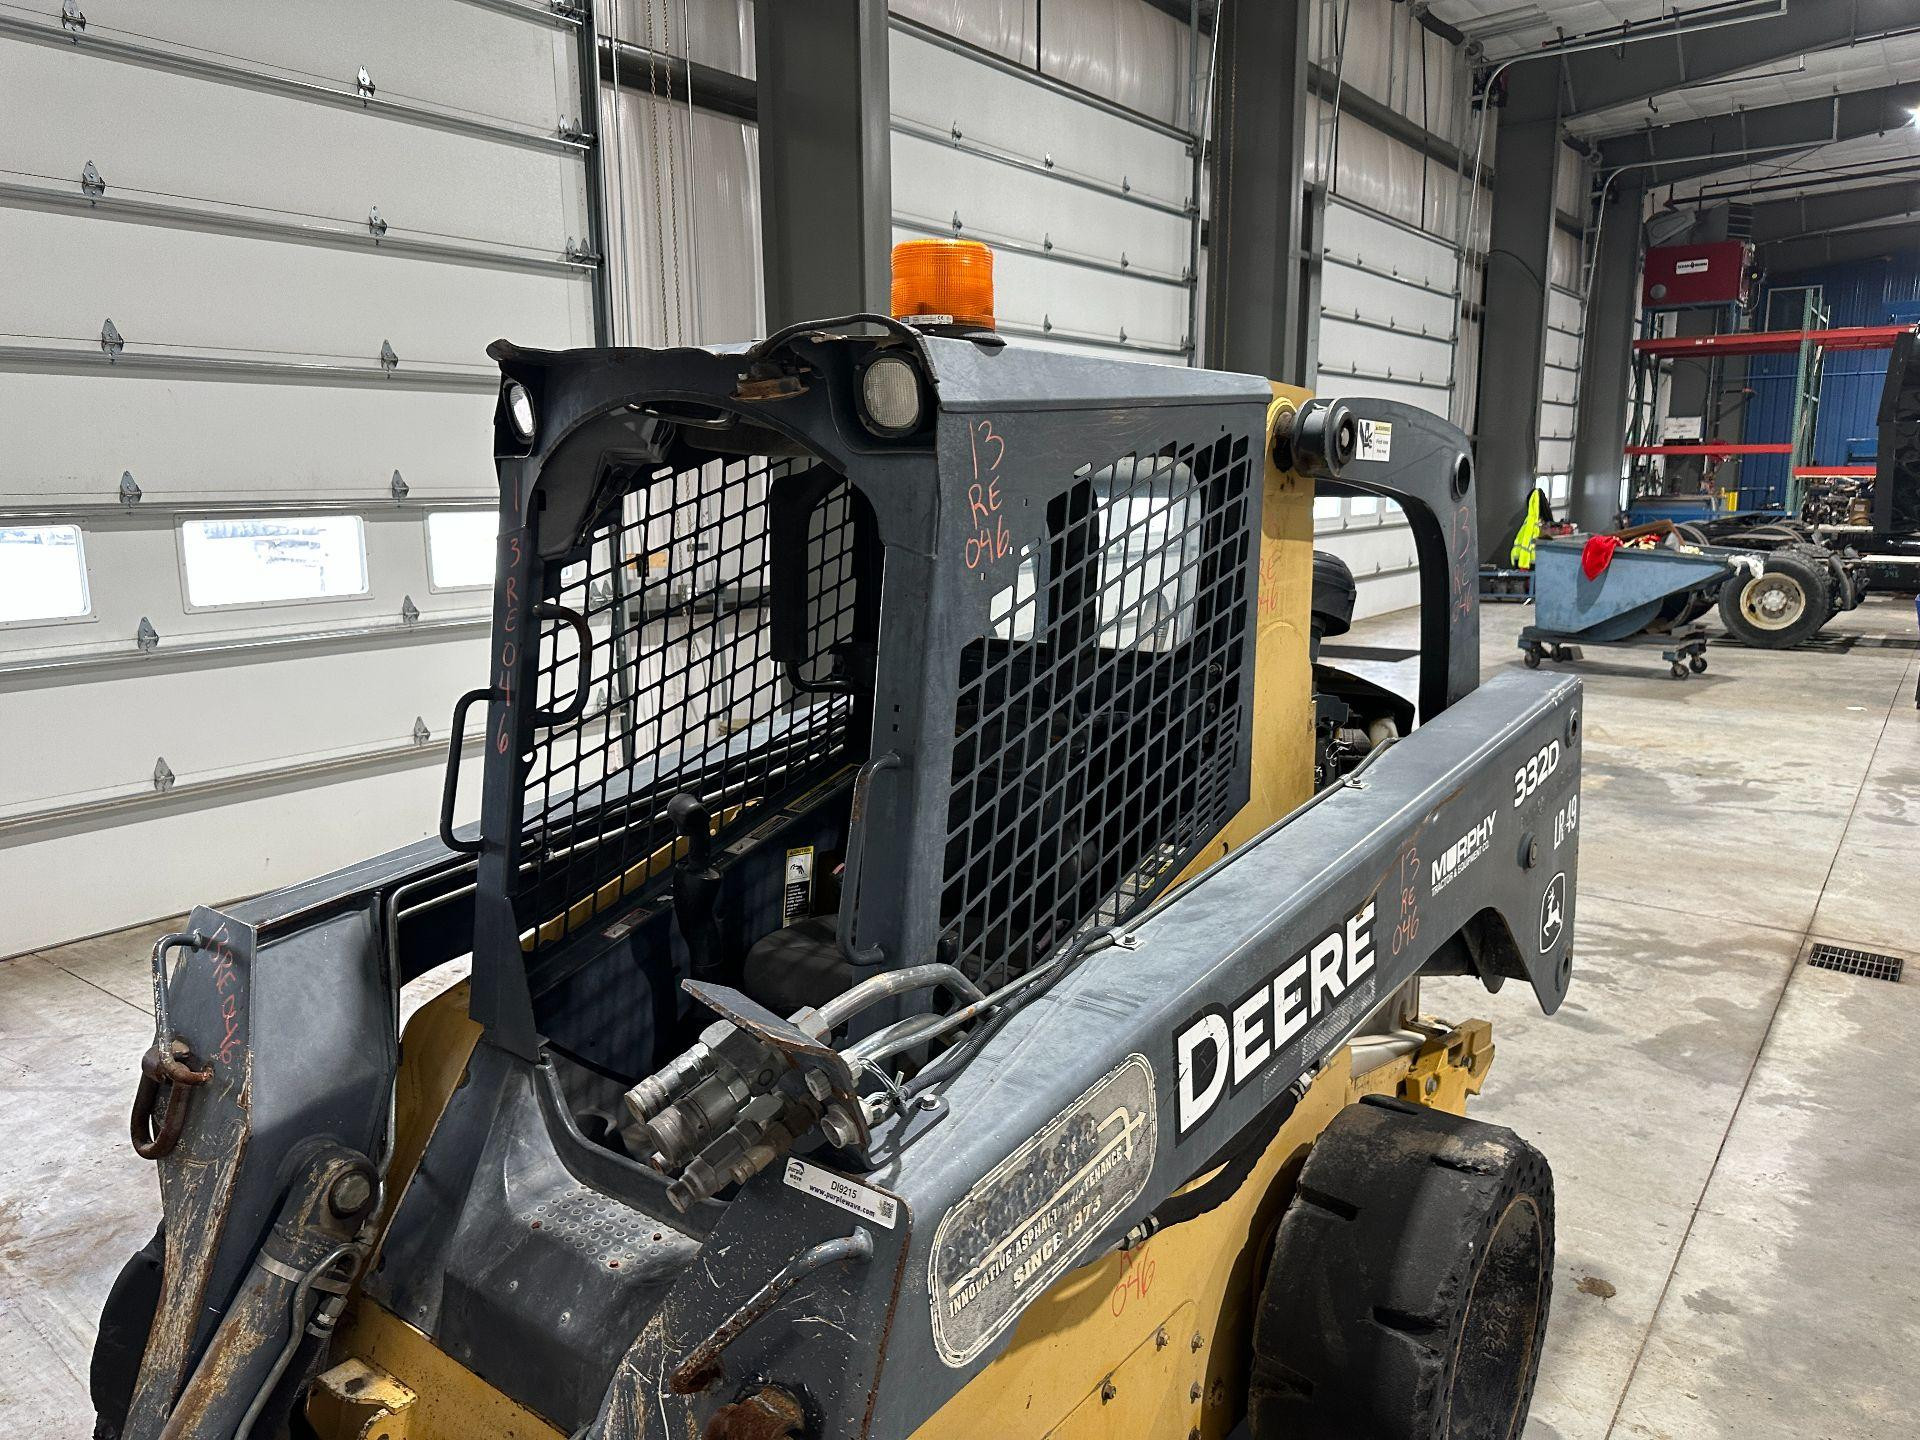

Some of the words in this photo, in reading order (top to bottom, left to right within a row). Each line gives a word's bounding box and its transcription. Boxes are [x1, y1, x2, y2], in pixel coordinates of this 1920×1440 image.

[968, 419, 1005, 481] 13
[968, 474, 1003, 531] RE
[965, 514, 1010, 570] 046
[1514, 739, 1560, 808] 332D
[1400, 847, 1421, 885] 13
[1392, 904, 1420, 956] 046
[1400, 885, 1416, 920] RE
[1177, 901, 1375, 1133] DEERE
[787, 1166, 804, 1176] purple
[789, 1173, 803, 1182] wave
[831, 1180, 858, 1199] DI9215
[809, 1184, 876, 1218] www.purplewave.com
[949, 1247, 1013, 1318] INNOVATIVE
[1014, 1207, 1060, 1257] ASPHALT
[1013, 1231, 1064, 1290] SINCE
[1111, 1246, 1155, 1317] 046
